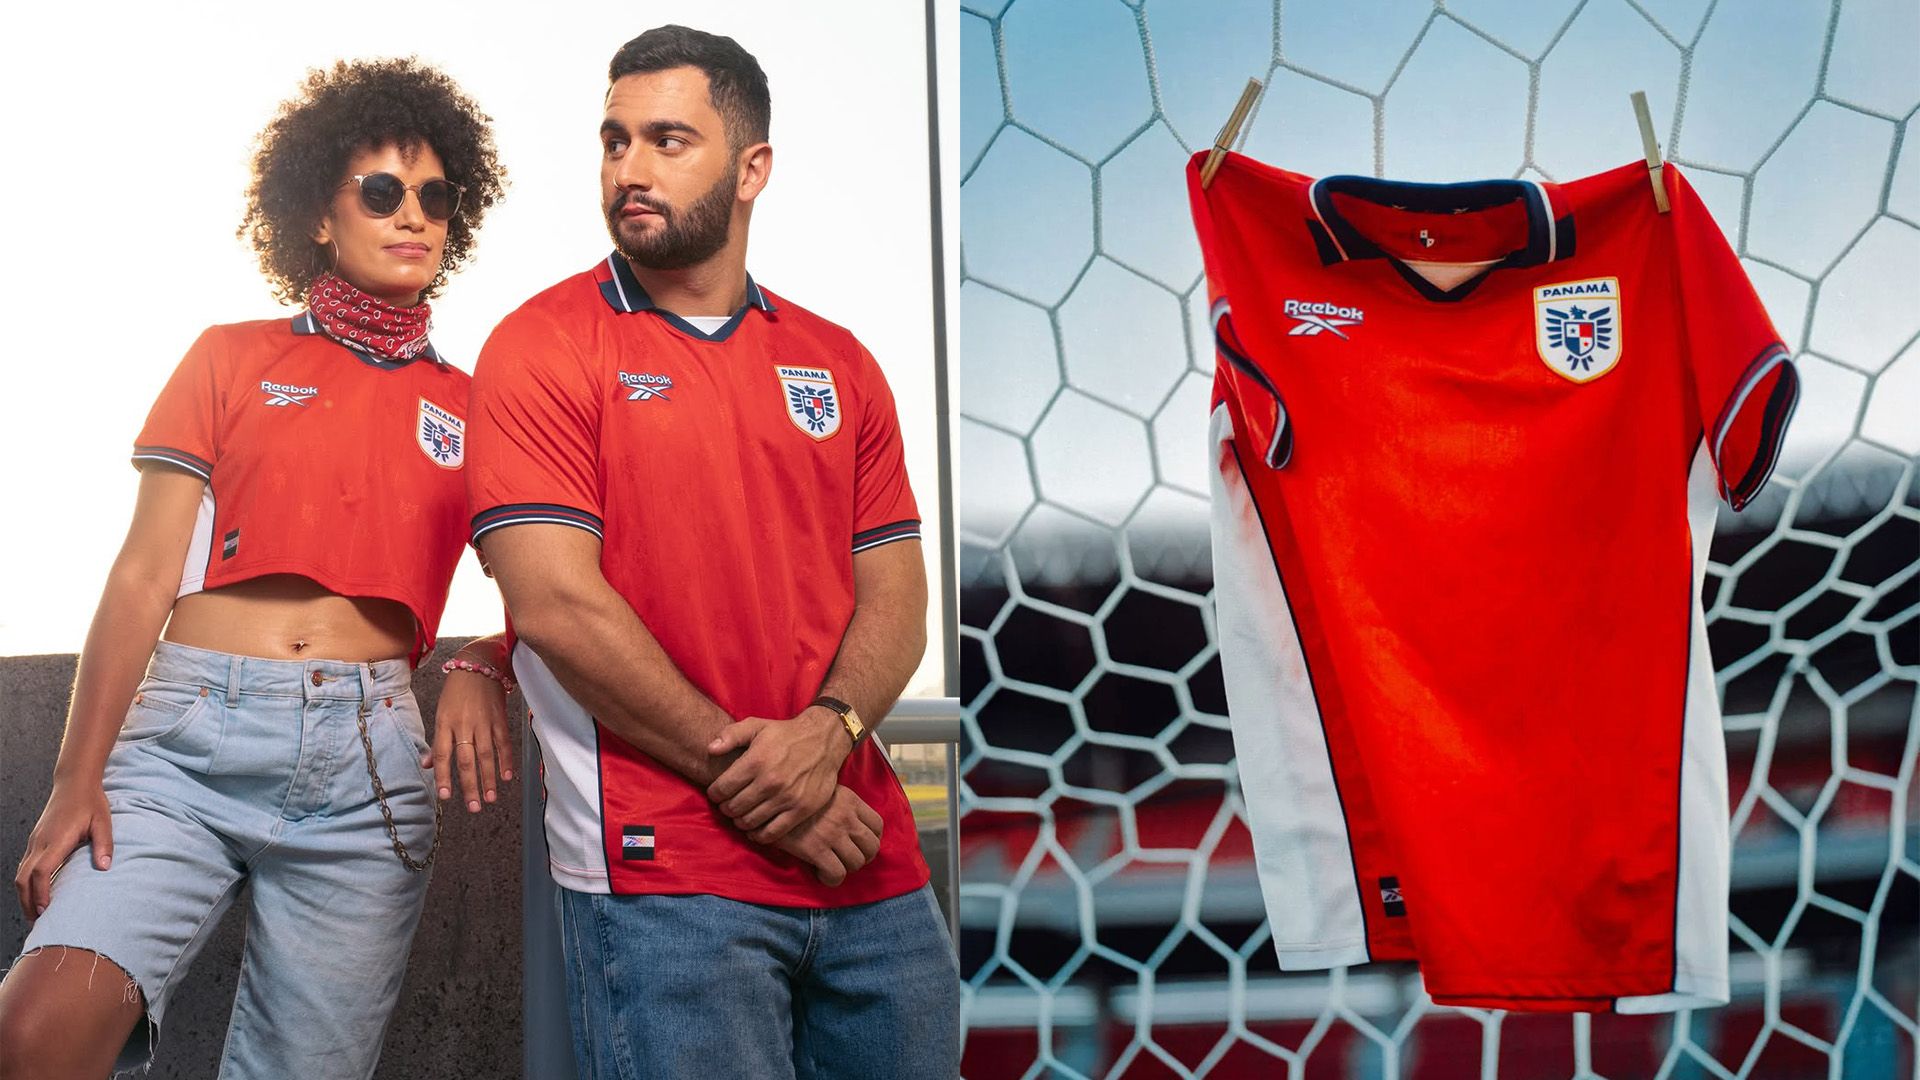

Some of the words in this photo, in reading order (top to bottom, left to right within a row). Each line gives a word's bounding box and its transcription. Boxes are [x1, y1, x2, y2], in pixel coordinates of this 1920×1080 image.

[1283, 299, 1363, 321] Reebok
[619, 370, 673, 385] Reebok
[261, 380, 318, 395] Reebok
